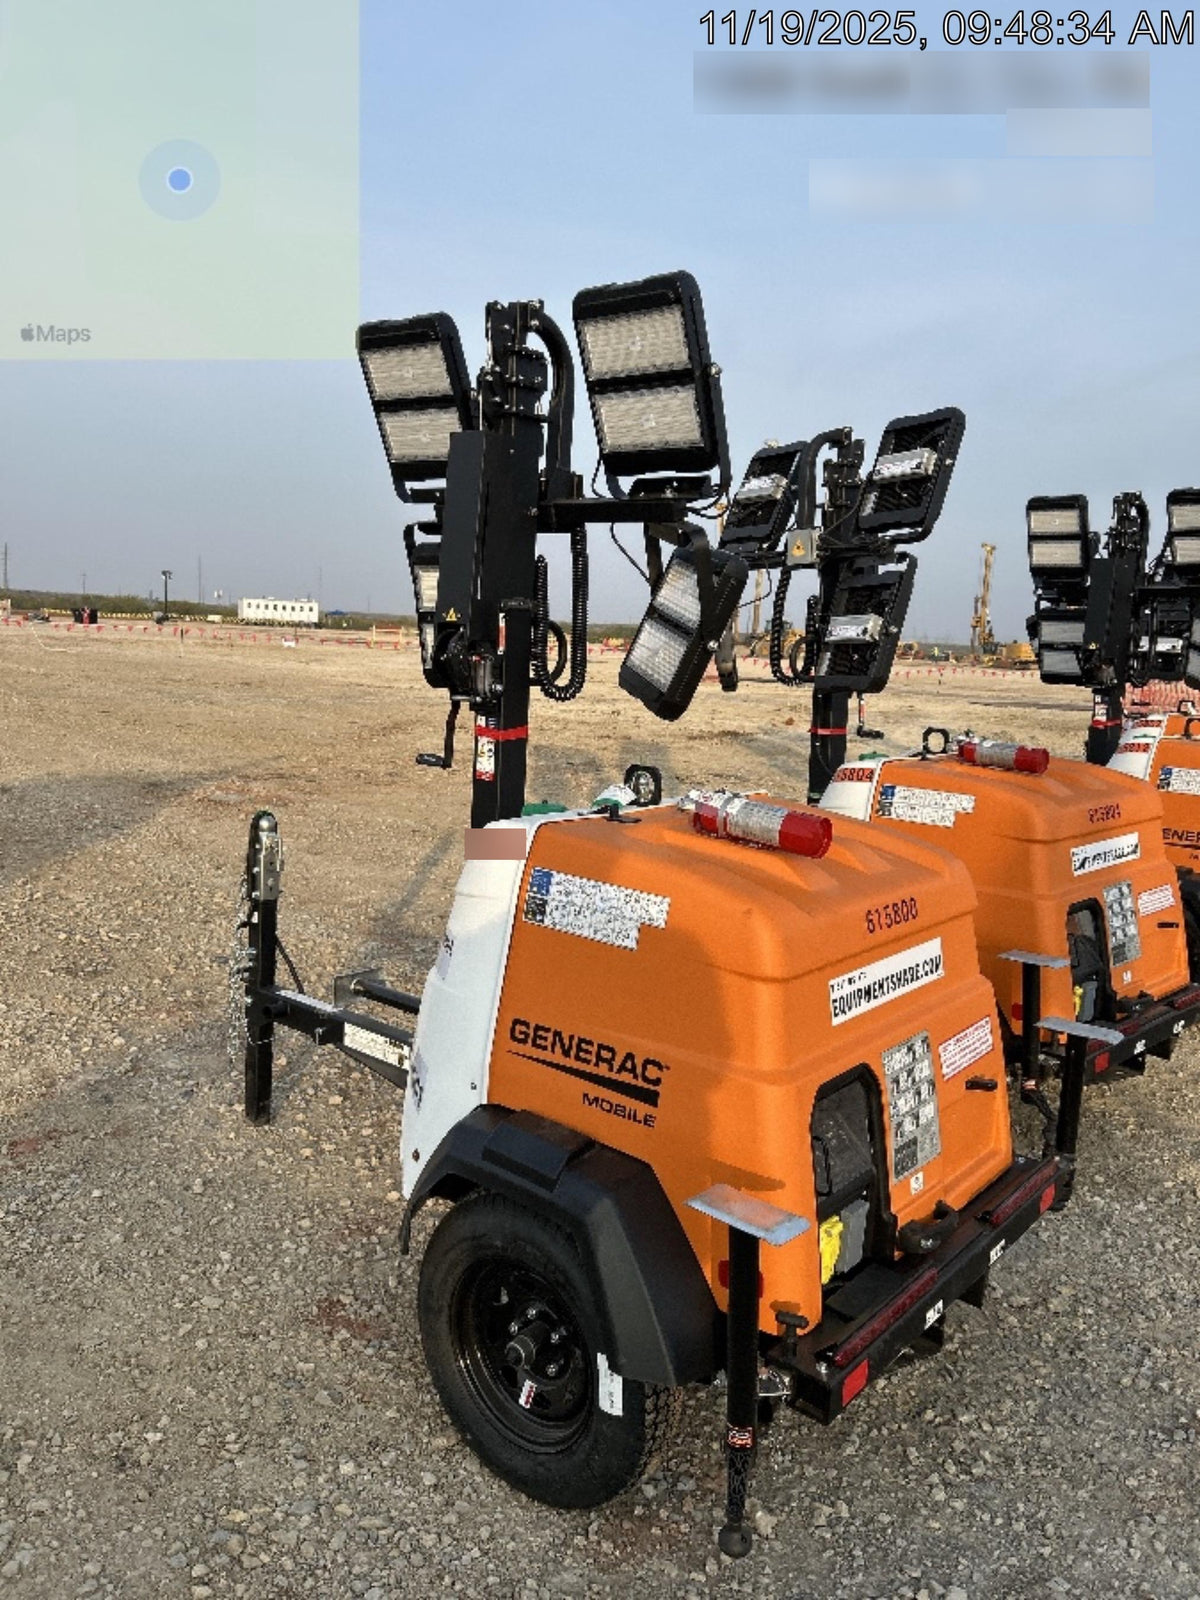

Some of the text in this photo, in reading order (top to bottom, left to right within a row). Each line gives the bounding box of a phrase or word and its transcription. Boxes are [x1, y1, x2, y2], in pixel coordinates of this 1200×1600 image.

[865, 897, 918, 934] 615800
[509, 1017, 664, 1087] GENERAC
[582, 1092, 657, 1128] MOBILE
